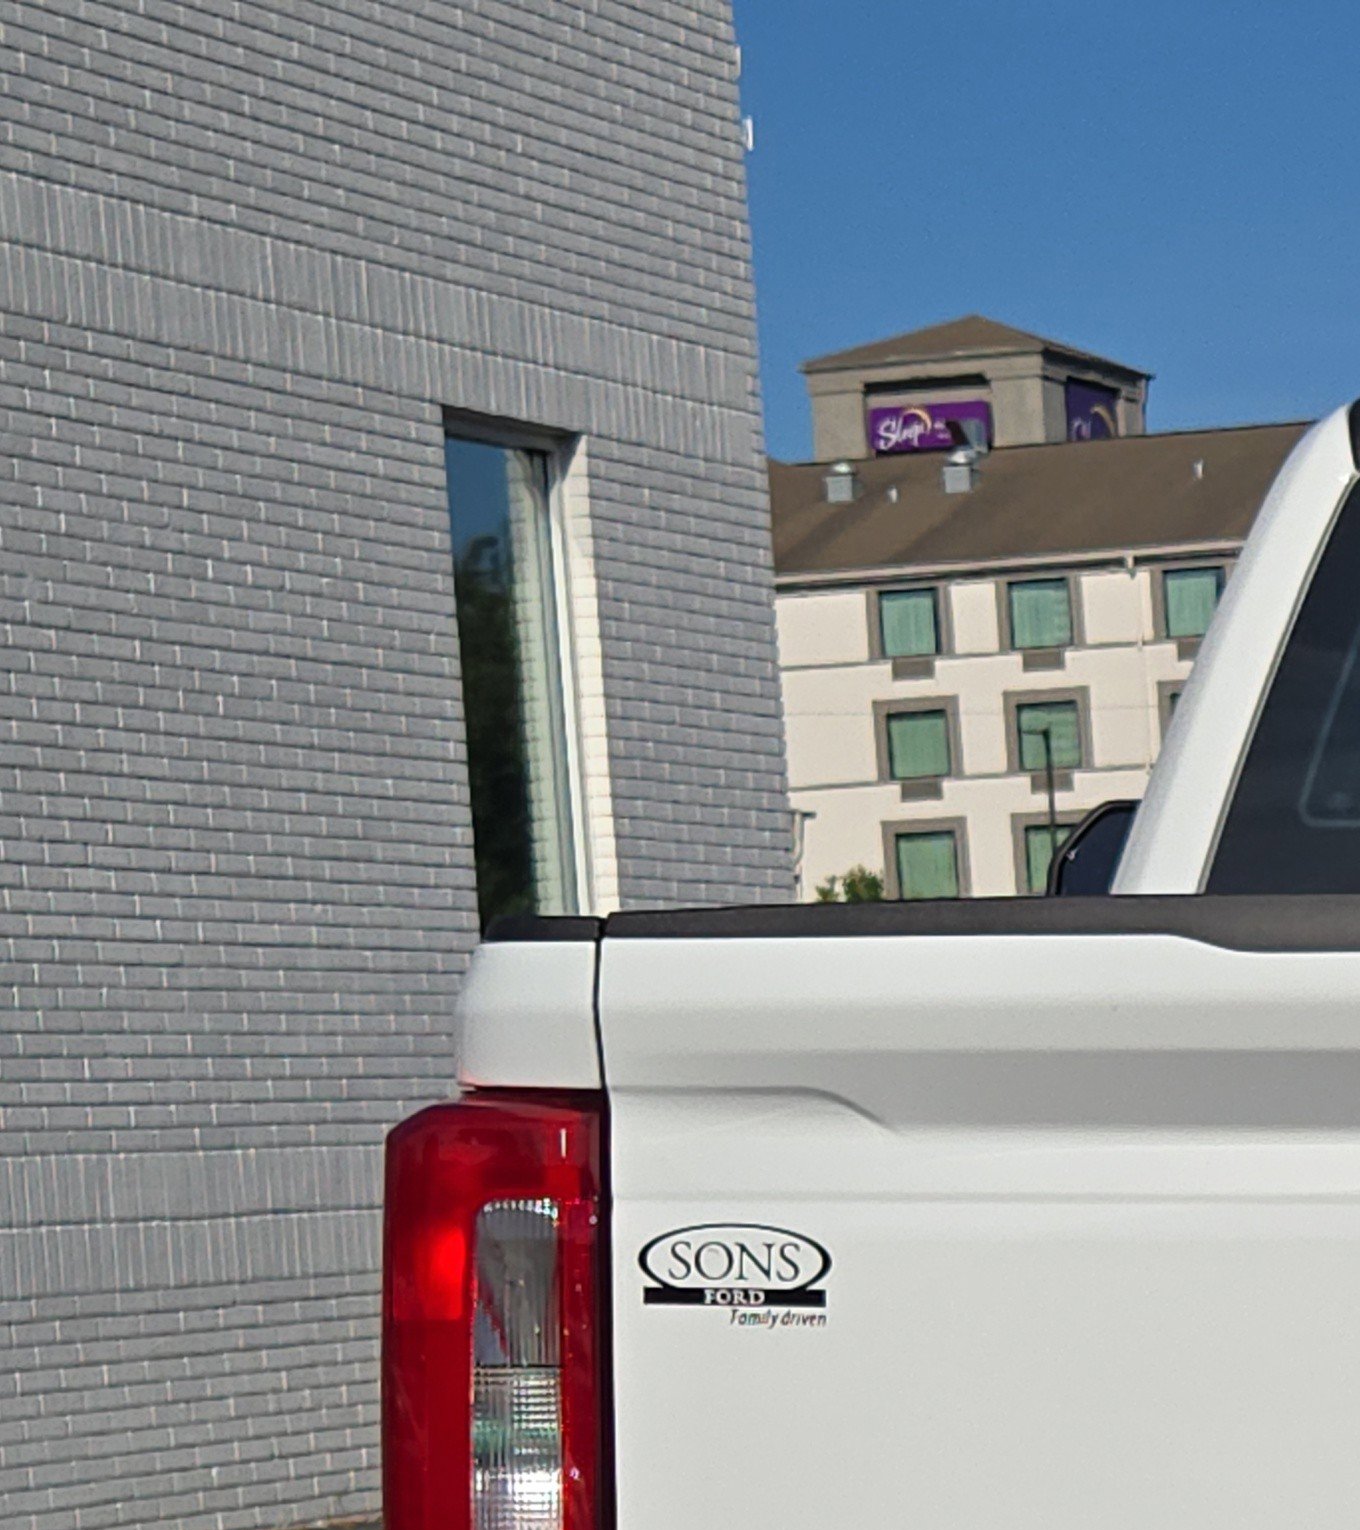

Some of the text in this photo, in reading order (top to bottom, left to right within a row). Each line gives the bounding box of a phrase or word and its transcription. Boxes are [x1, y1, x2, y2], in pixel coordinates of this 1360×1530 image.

[667, 1240, 801, 1282] SONS
[703, 1288, 766, 1305] FORD
[729, 1308, 827, 1330] Family driven
